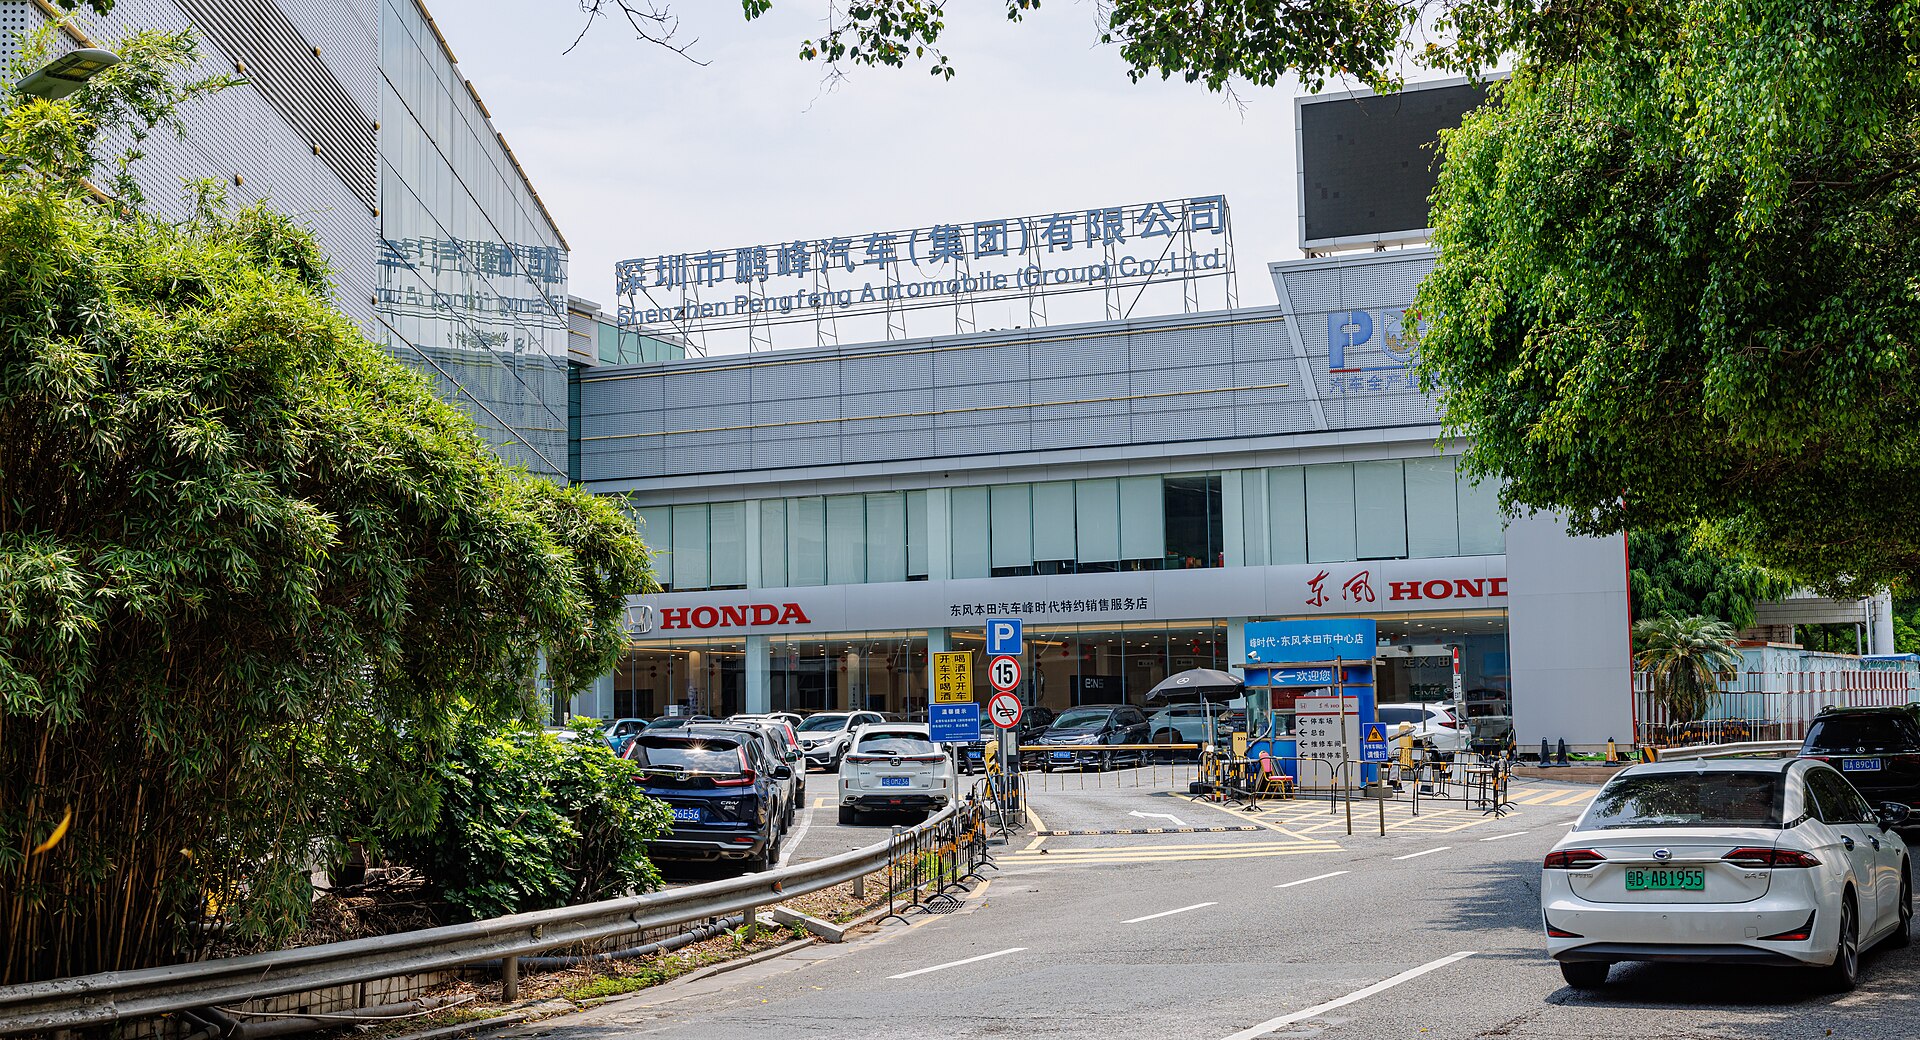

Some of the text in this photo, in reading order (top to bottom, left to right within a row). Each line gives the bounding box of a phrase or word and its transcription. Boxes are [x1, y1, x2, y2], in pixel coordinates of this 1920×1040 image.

[617, 300, 728, 326] Shenzhen
[734, 289, 852, 314] Pengfeng
[861, 269, 1008, 301] Automobile
[1016, 259, 1111, 290] (Group)
[659, 603, 811, 629] HONDA
[950, 597, 1148, 616] 东风本田汽车峰时代特约销售服务店
[994, 622, 1015, 650] P
[1250, 633, 1364, 648] 峰时代·东风本田市中心店
[940, 654, 951, 700] 开车不喝酒
[954, 654, 966, 700] 喝酒不开车
[996, 664, 1013, 684] 15
[1296, 669, 1331, 682] 欢迎您
[1310, 717, 1333, 725] 停车场
[1310, 729, 1325, 737] 总台
